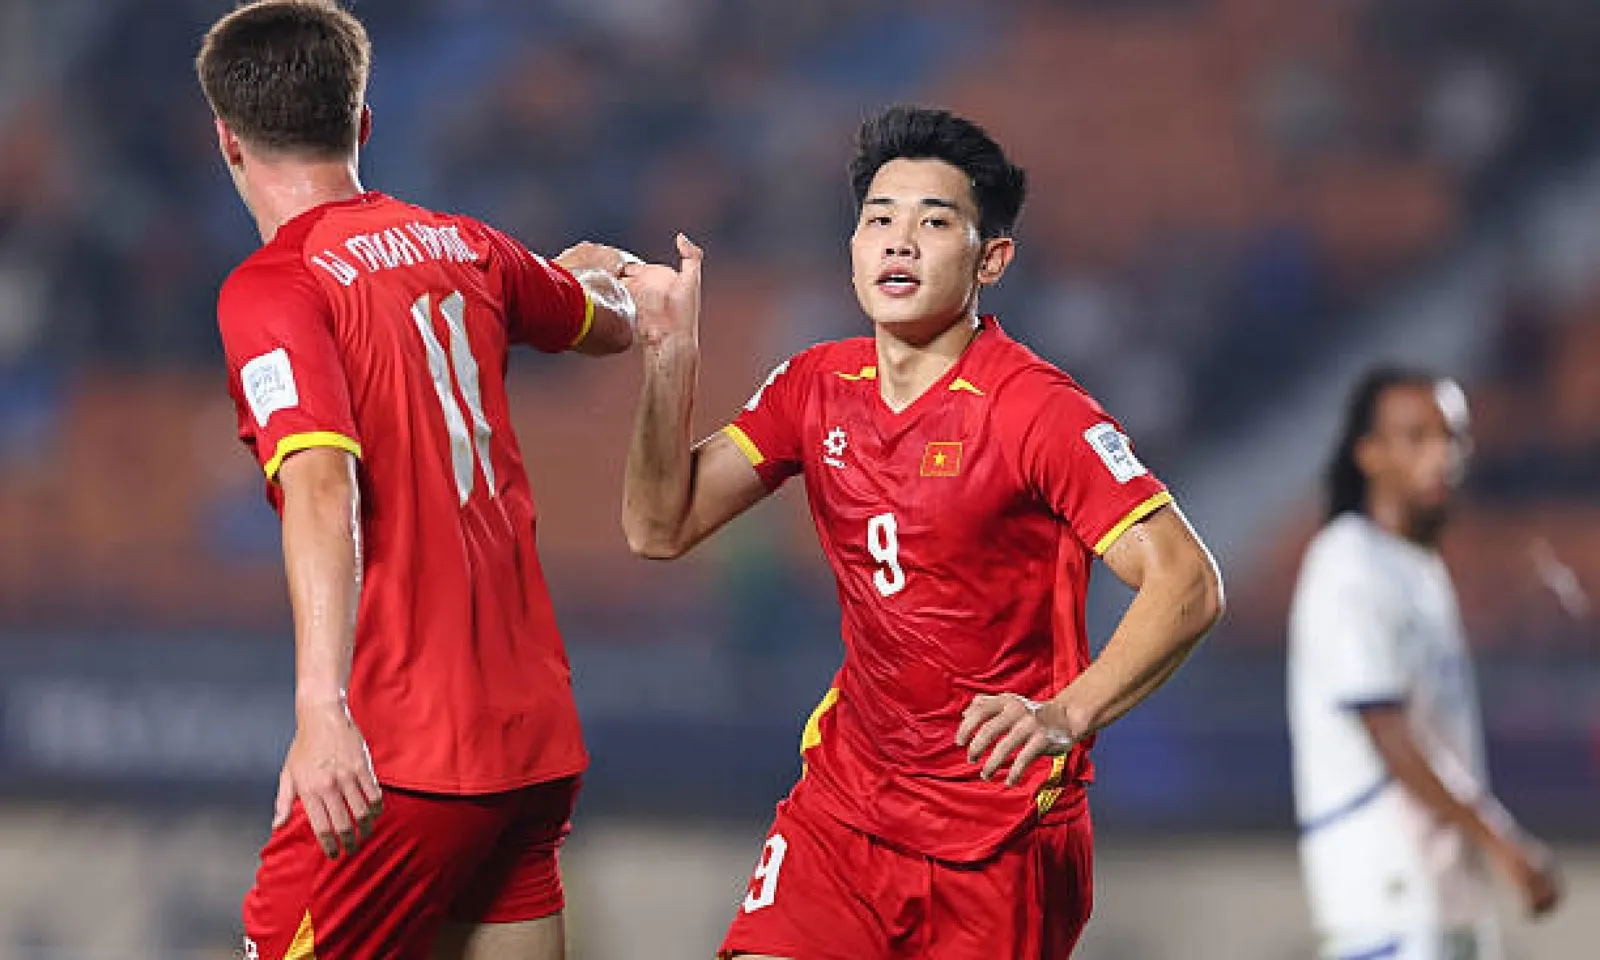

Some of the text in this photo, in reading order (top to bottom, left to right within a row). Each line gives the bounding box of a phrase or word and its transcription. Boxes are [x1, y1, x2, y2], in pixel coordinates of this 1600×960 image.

[410, 289, 493, 508] 11
[867, 512, 906, 597] 9
[743, 833, 788, 914] 9
